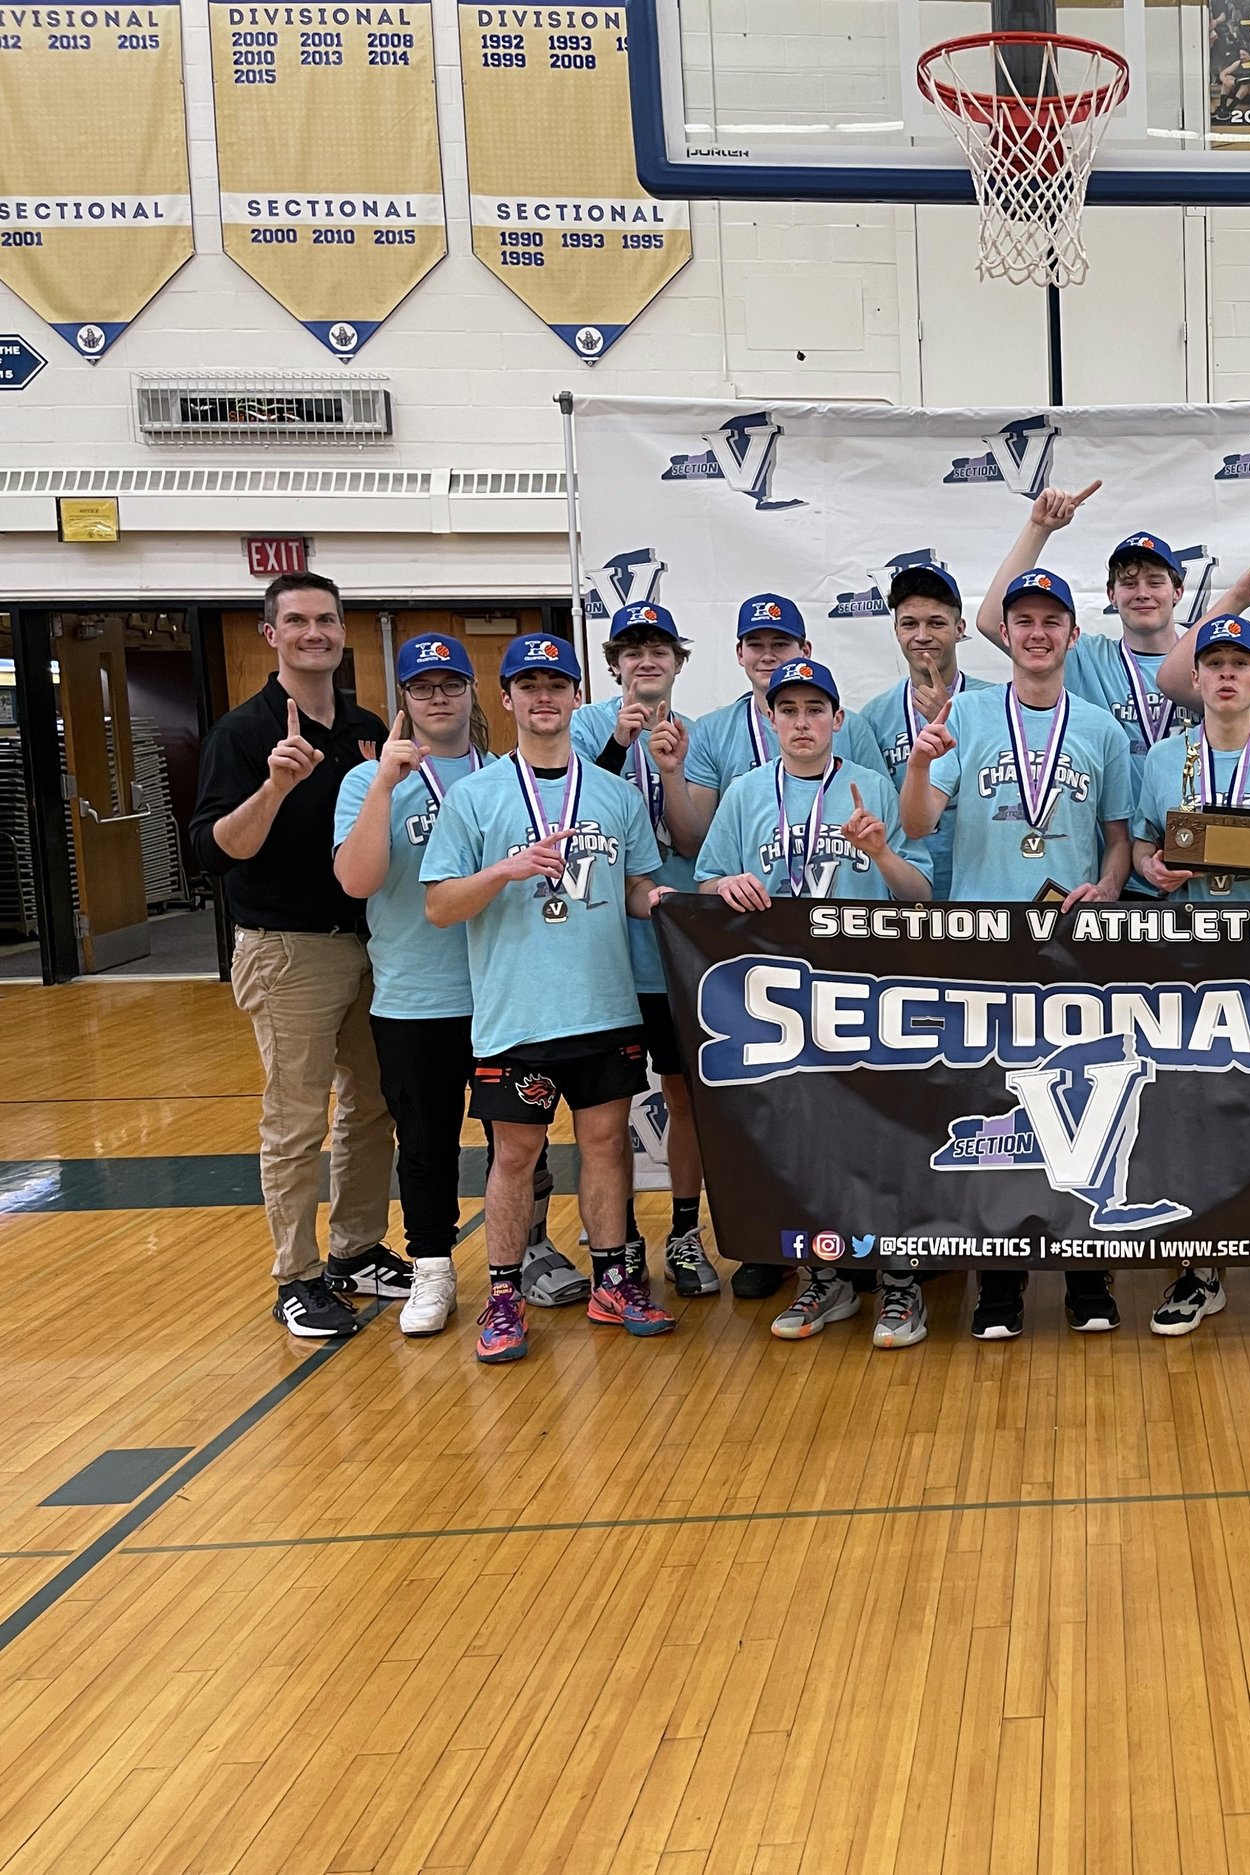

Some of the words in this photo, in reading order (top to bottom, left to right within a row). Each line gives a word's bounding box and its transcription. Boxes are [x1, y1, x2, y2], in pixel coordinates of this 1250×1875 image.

[229, 8, 411, 26] DIVISIONAL
[0, 34, 22, 50] 12
[48, 34, 91, 50] 2013
[117, 34, 159, 50] 2015
[232, 31, 278, 47] 2000
[300, 32, 342, 48] 2001
[367, 33, 413, 49] 2008
[481, 34, 524, 50] 1992
[549, 35, 592, 51] 1993
[233, 50, 275, 66] 2010
[300, 50, 343, 66] 2013
[368, 50, 409, 66] 2014
[482, 52, 526, 68] 1999
[550, 54, 596, 70] 2008
[234, 68, 276, 84] 2015
[0, 202, 164, 219] SECTIONAL
[248, 200, 417, 218] SECTIONAL
[496, 203, 664, 223] SECTIONAL
[1, 231, 43, 247] 2001
[251, 228, 297, 244] 2000
[313, 229, 355, 245] 2010
[374, 230, 416, 245] 2015
[500, 231, 543, 247] 1990
[562, 233, 605, 248] 1993
[622, 234, 664, 249] 1995
[500, 251, 545, 267] 1996
[671, 461, 718, 477] SECTION
[702, 424, 785, 493] V
[953, 464, 997, 479] SECTION
[982, 424, 1062, 493] V
[250, 541, 300, 571] EXIT
[838, 598, 883, 614] SECTION
[1027, 838, 1041, 851] V
[1180, 833, 1190, 842] V
[1214, 875, 1228, 889] V
[549, 901, 564, 916] V
[810, 907, 1010, 942] SECTION
[1029, 910, 1068, 942] V
[952, 1133, 1034, 1158] SECTION
[1004, 1060, 1157, 1191] V
[880, 1236, 1031, 1257] @SECVATHLETICS
[1050, 1239, 1145, 1259] #SECTIONV
